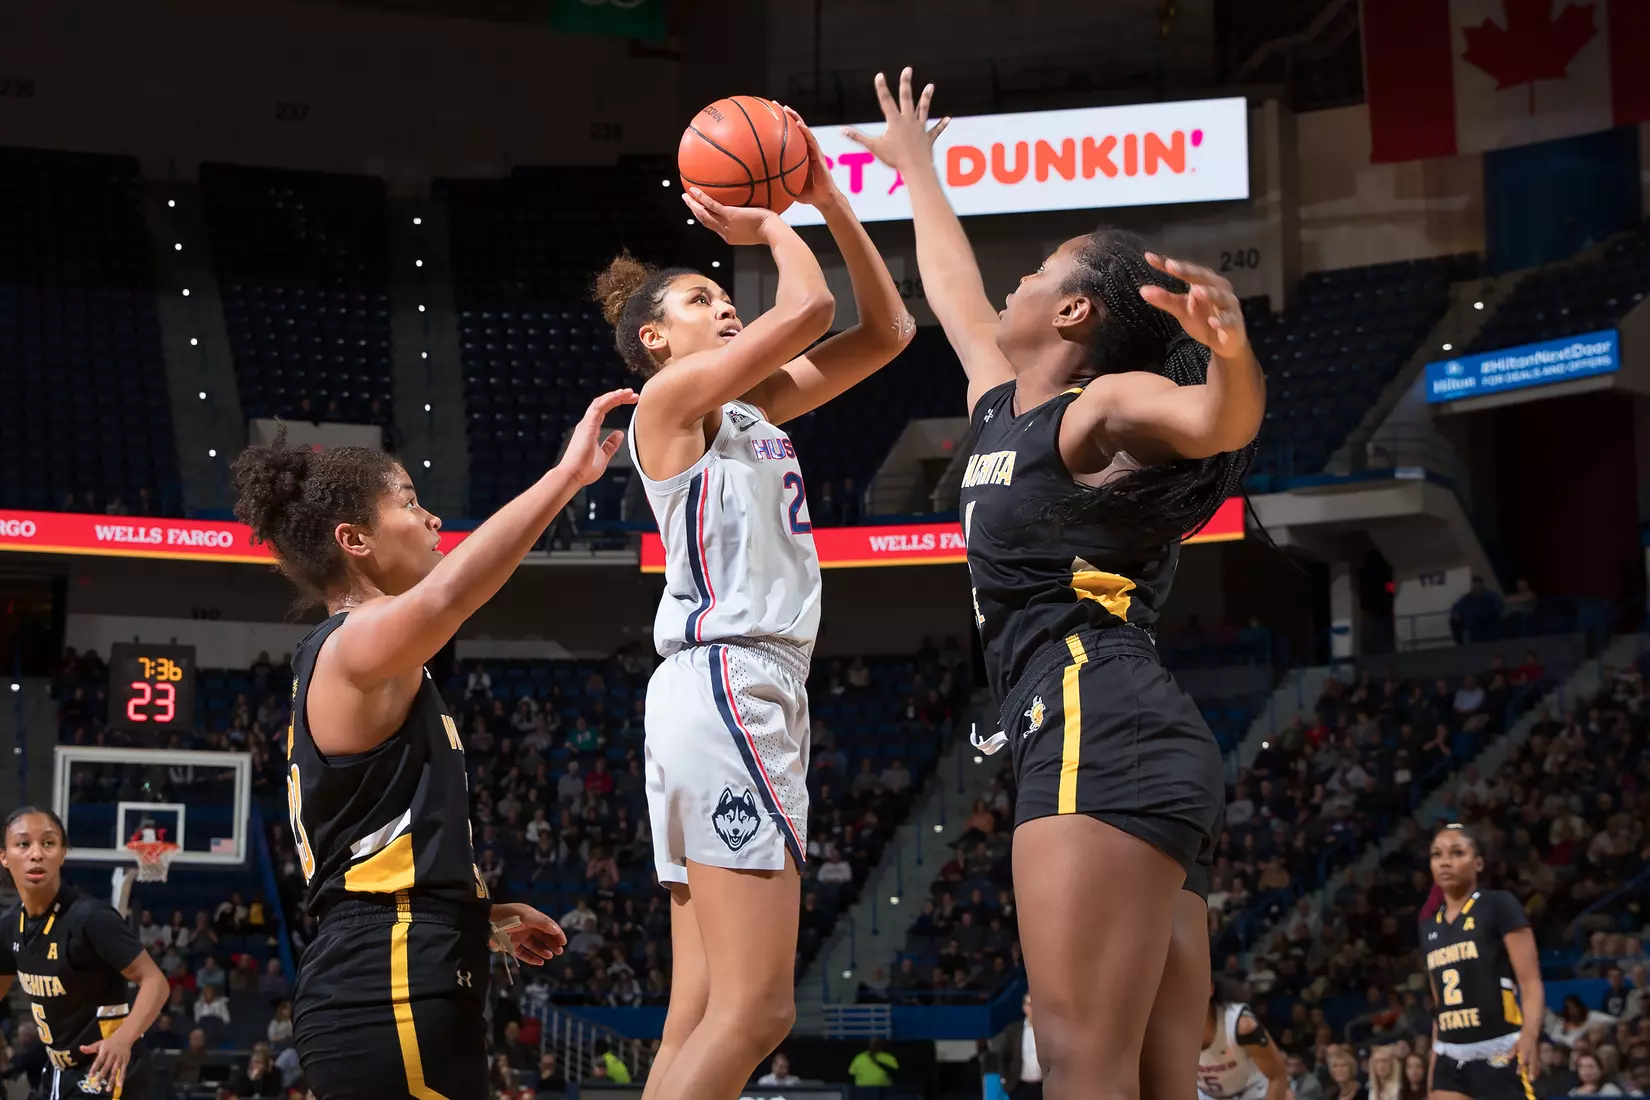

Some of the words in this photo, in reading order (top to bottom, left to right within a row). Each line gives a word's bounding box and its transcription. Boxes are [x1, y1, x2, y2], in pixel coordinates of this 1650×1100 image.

[946, 129, 1203, 187] DUNKIN'
[1220, 248, 1260, 271] 240
[1432, 376, 1477, 394] Hilton
[95, 524, 163, 544] WELLS
[167, 528, 234, 547] FARGO
[868, 533, 936, 552] WELLS
[138, 657, 183, 681] 7:36
[127, 682, 176, 722] 23
[1442, 968, 1463, 1006] 2
[31, 1002, 53, 1044] 5
[1438, 1007, 1481, 1031] STATE
